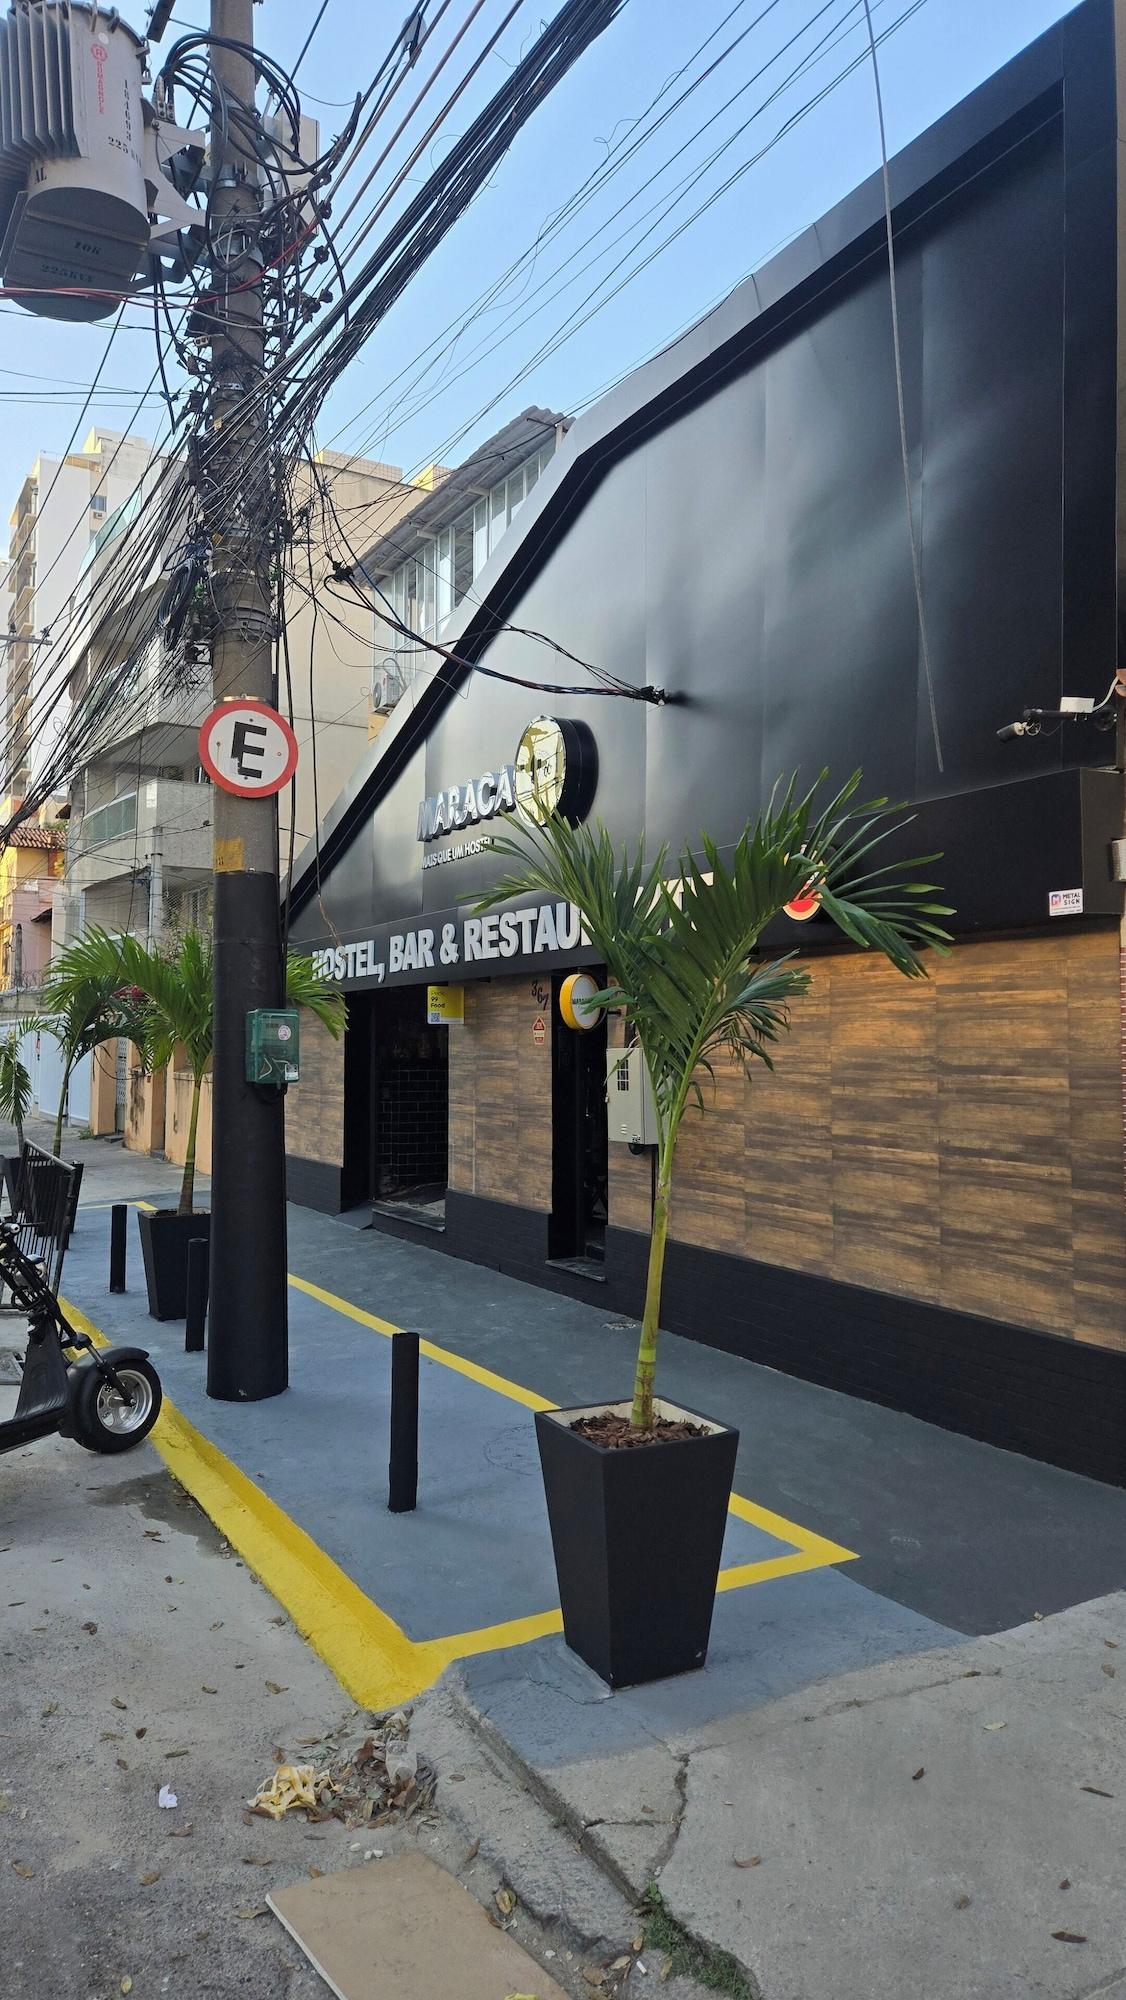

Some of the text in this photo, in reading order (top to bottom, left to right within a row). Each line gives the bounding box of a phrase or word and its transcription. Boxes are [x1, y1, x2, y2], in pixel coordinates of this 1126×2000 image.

[231, 721, 267, 779] E
[422, 852, 438, 869] MAIS
[437, 848, 452, 864] QUE
[452, 844, 464, 860] UM
[1062, 892, 1081, 900] METAL
[1063, 898, 1080, 906] SIGN
[311, 939, 385, 984] HOSTEL,
[389, 928, 435, 974] BAR
[440, 923, 459, 965] &
[531, 980, 549, 1012] 367
